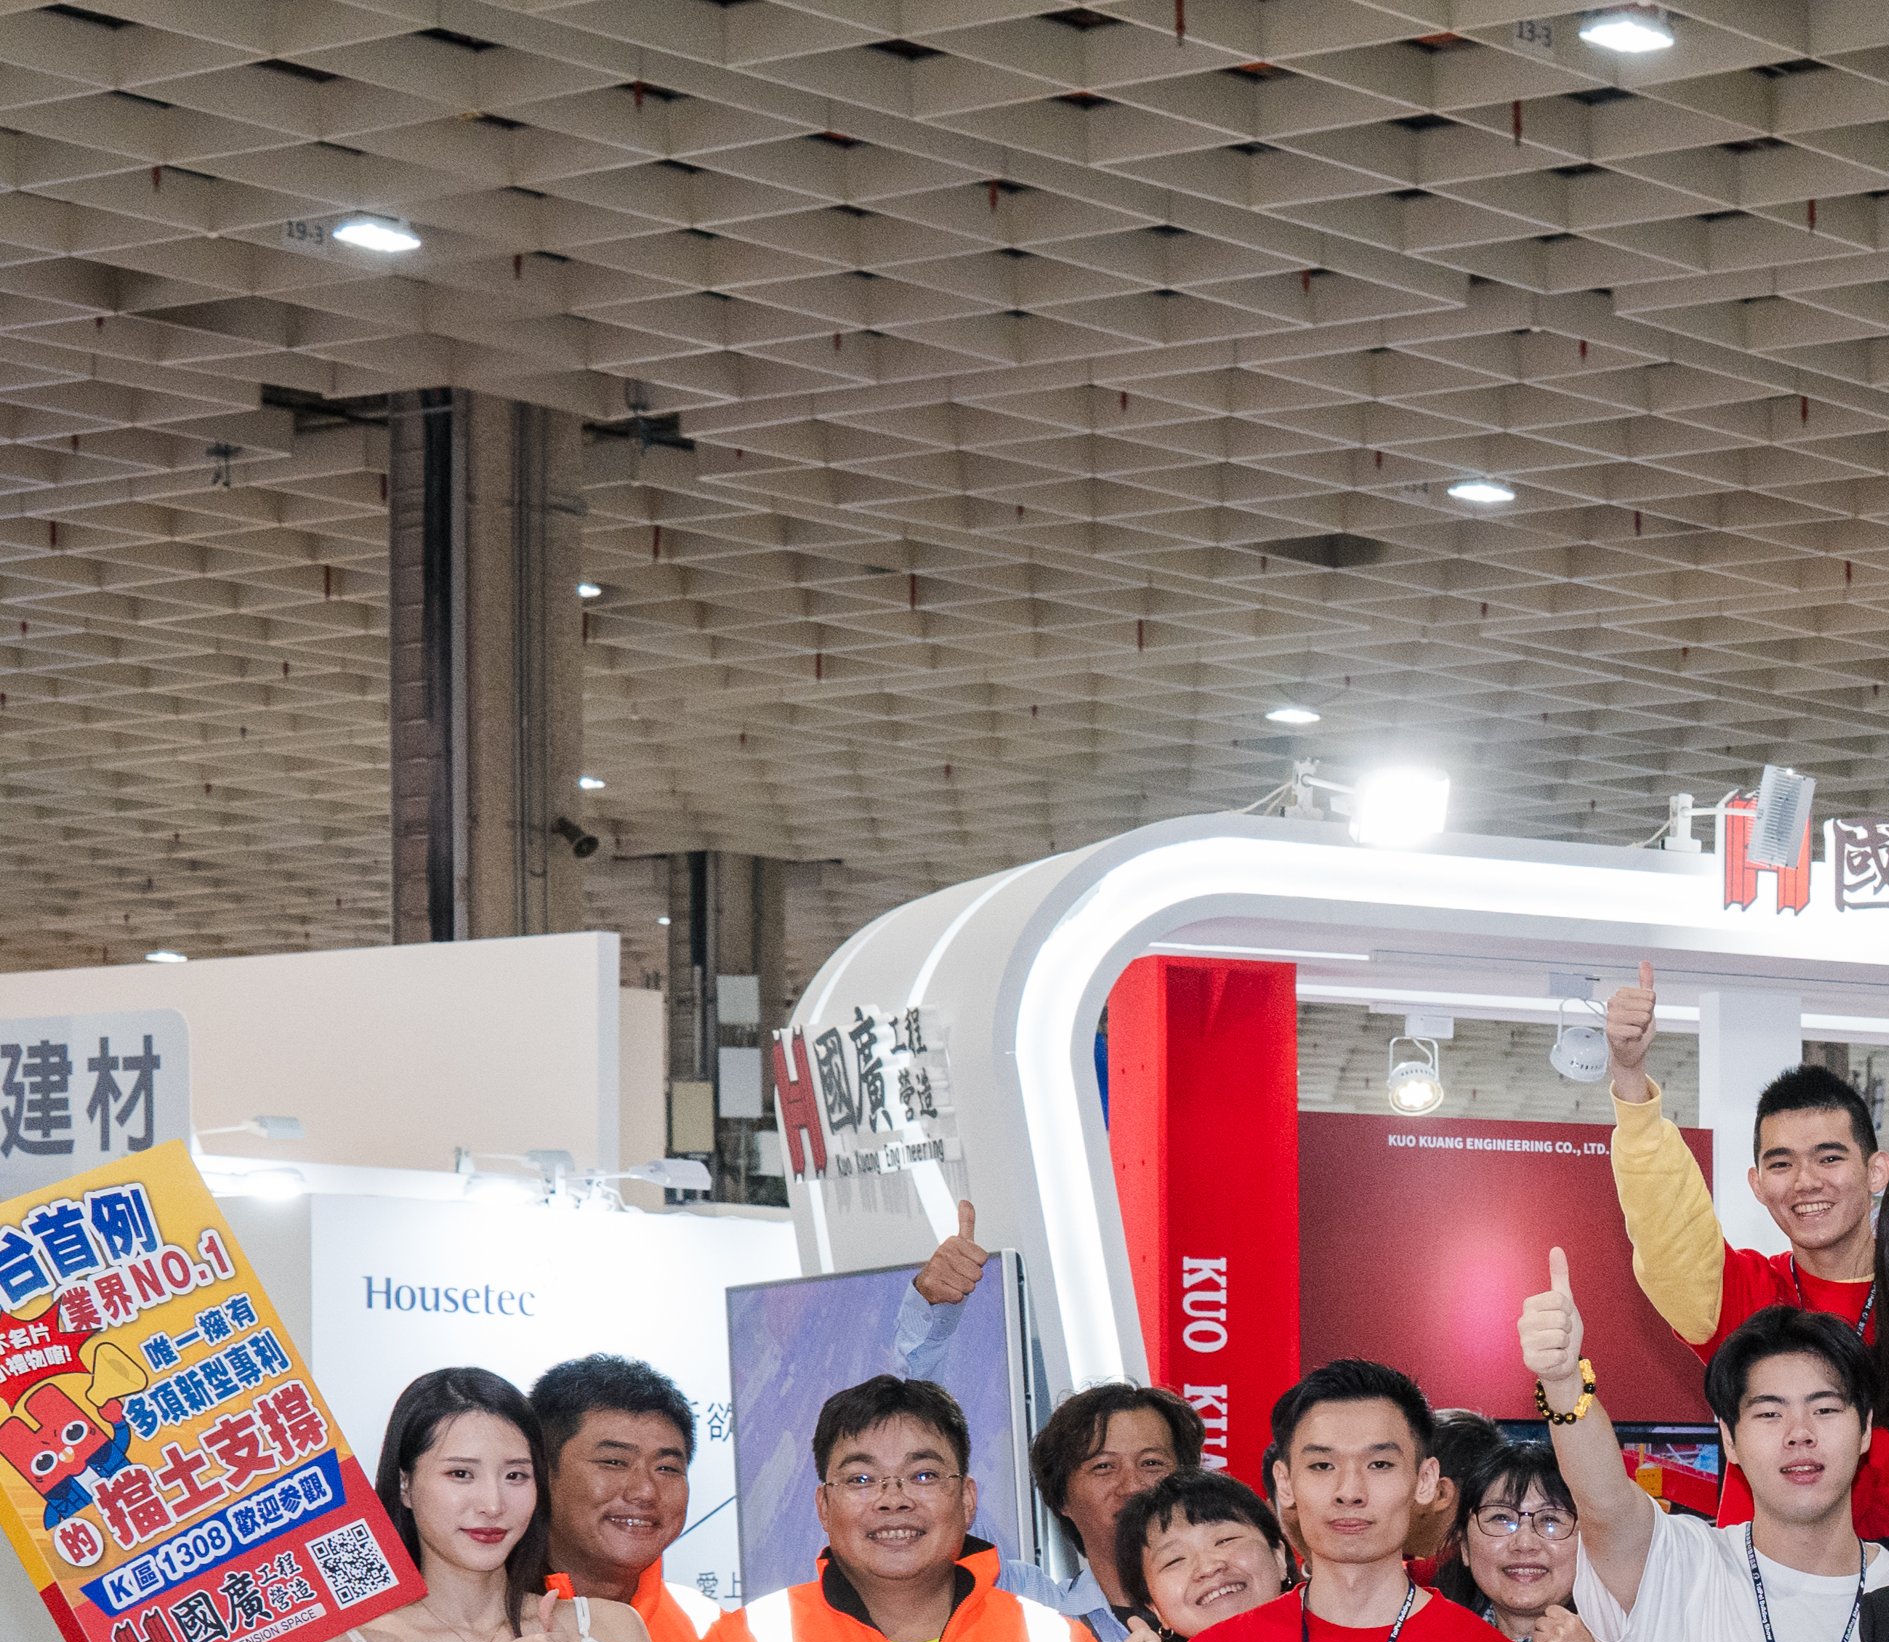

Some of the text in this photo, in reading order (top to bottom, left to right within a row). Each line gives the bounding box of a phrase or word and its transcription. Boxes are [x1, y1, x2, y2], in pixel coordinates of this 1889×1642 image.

[0, 1034, 161, 1158] 建材
[813, 1005, 893, 1135] 國廣
[888, 1006, 928, 1056] 工程
[897, 1068, 938, 1122] 營造
[1388, 1134, 1610, 1157] KUO KUANG ENGINEERING CO., LTD.
[61, 1234, 232, 1332] 業界NO.1
[362, 1275, 536, 1318] Housetec
[1181, 1256, 1229, 1354] KUO
[144, 1294, 258, 1372] 唯一擁有
[125, 1328, 292, 1440] 多項新型專利
[58, 1382, 331, 1564] 的 擋土支撐
[256, 1551, 303, 1588] 工程
[268, 1579, 317, 1613] 營造
[279, 1608, 318, 1637] SPACE
